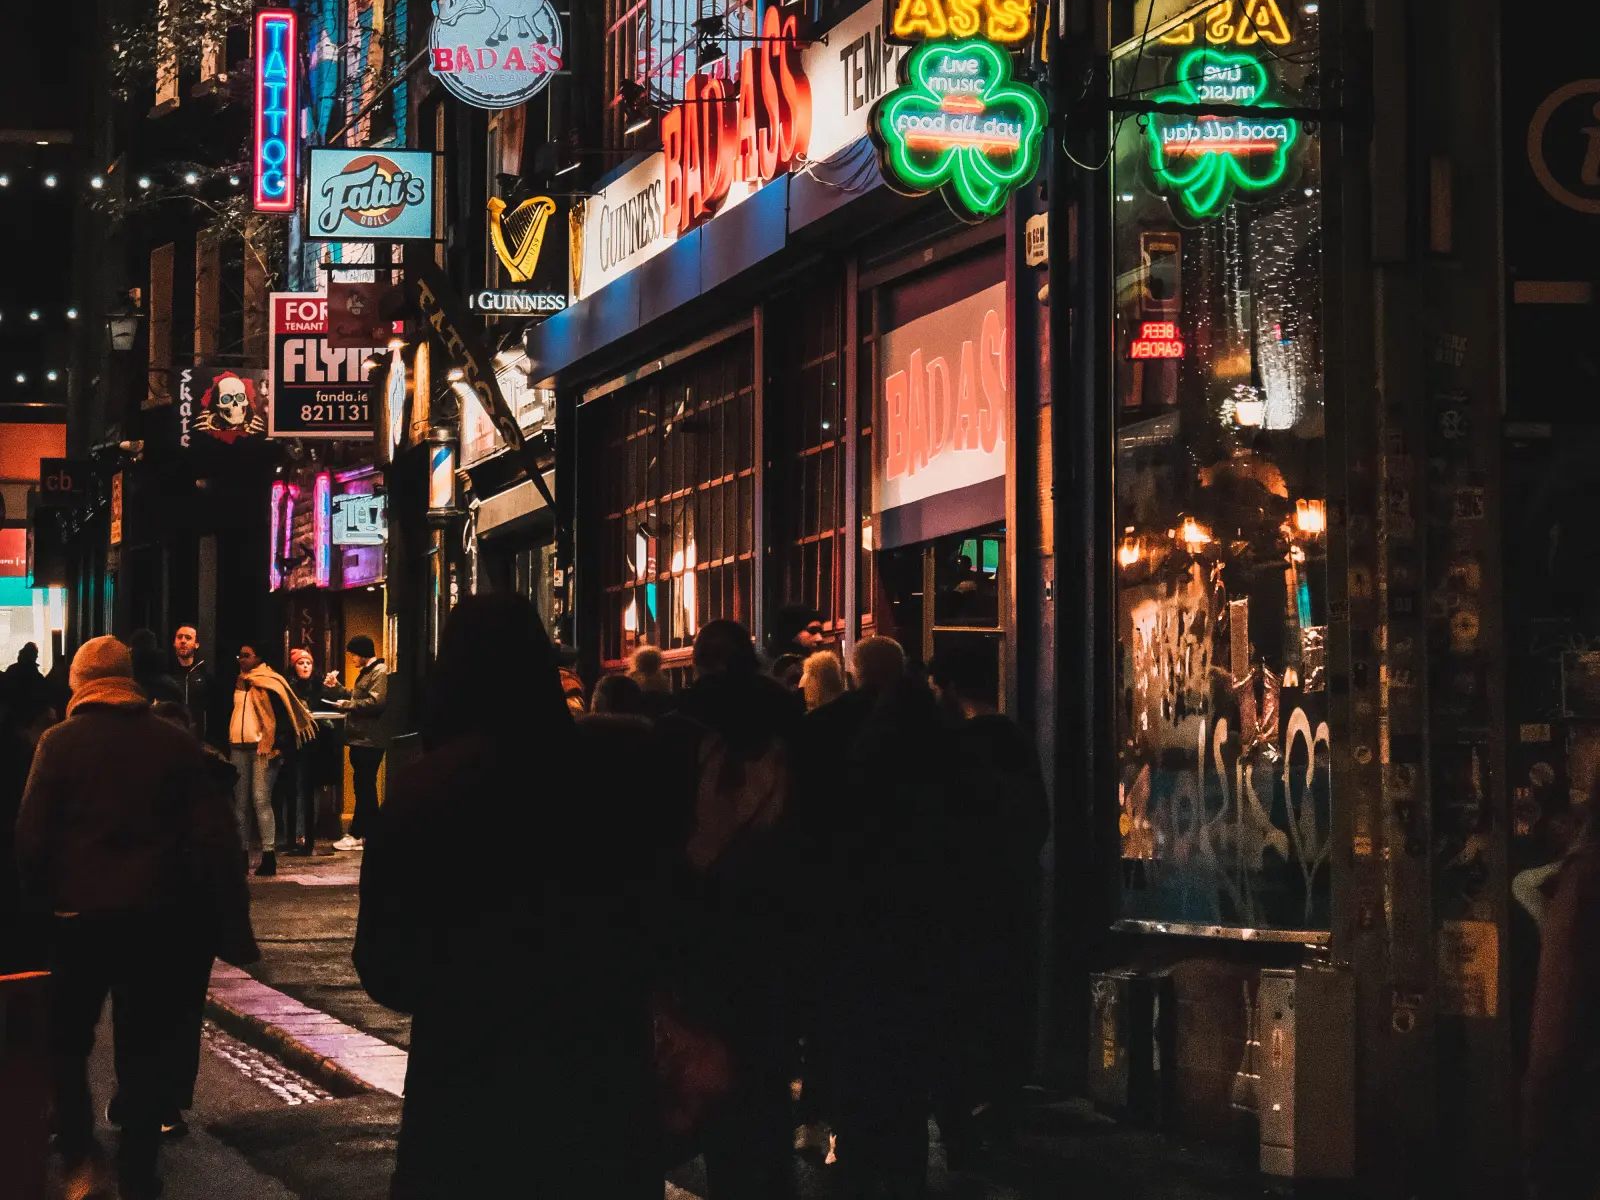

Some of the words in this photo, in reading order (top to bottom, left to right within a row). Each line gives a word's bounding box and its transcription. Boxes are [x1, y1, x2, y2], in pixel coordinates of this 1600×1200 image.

[840, 23, 900, 116] TEMP
[928, 76, 986, 94] music
[897, 114, 945, 132] food
[983, 117, 1022, 140] day
[360, 213, 391, 226] GRILL
[600, 178, 661, 273] GUINNESS
[285, 301, 328, 321] FOR
[477, 291, 566, 312] GUINNESS
[285, 322, 324, 331] TENANT
[300, 404, 369, 421] 821131
